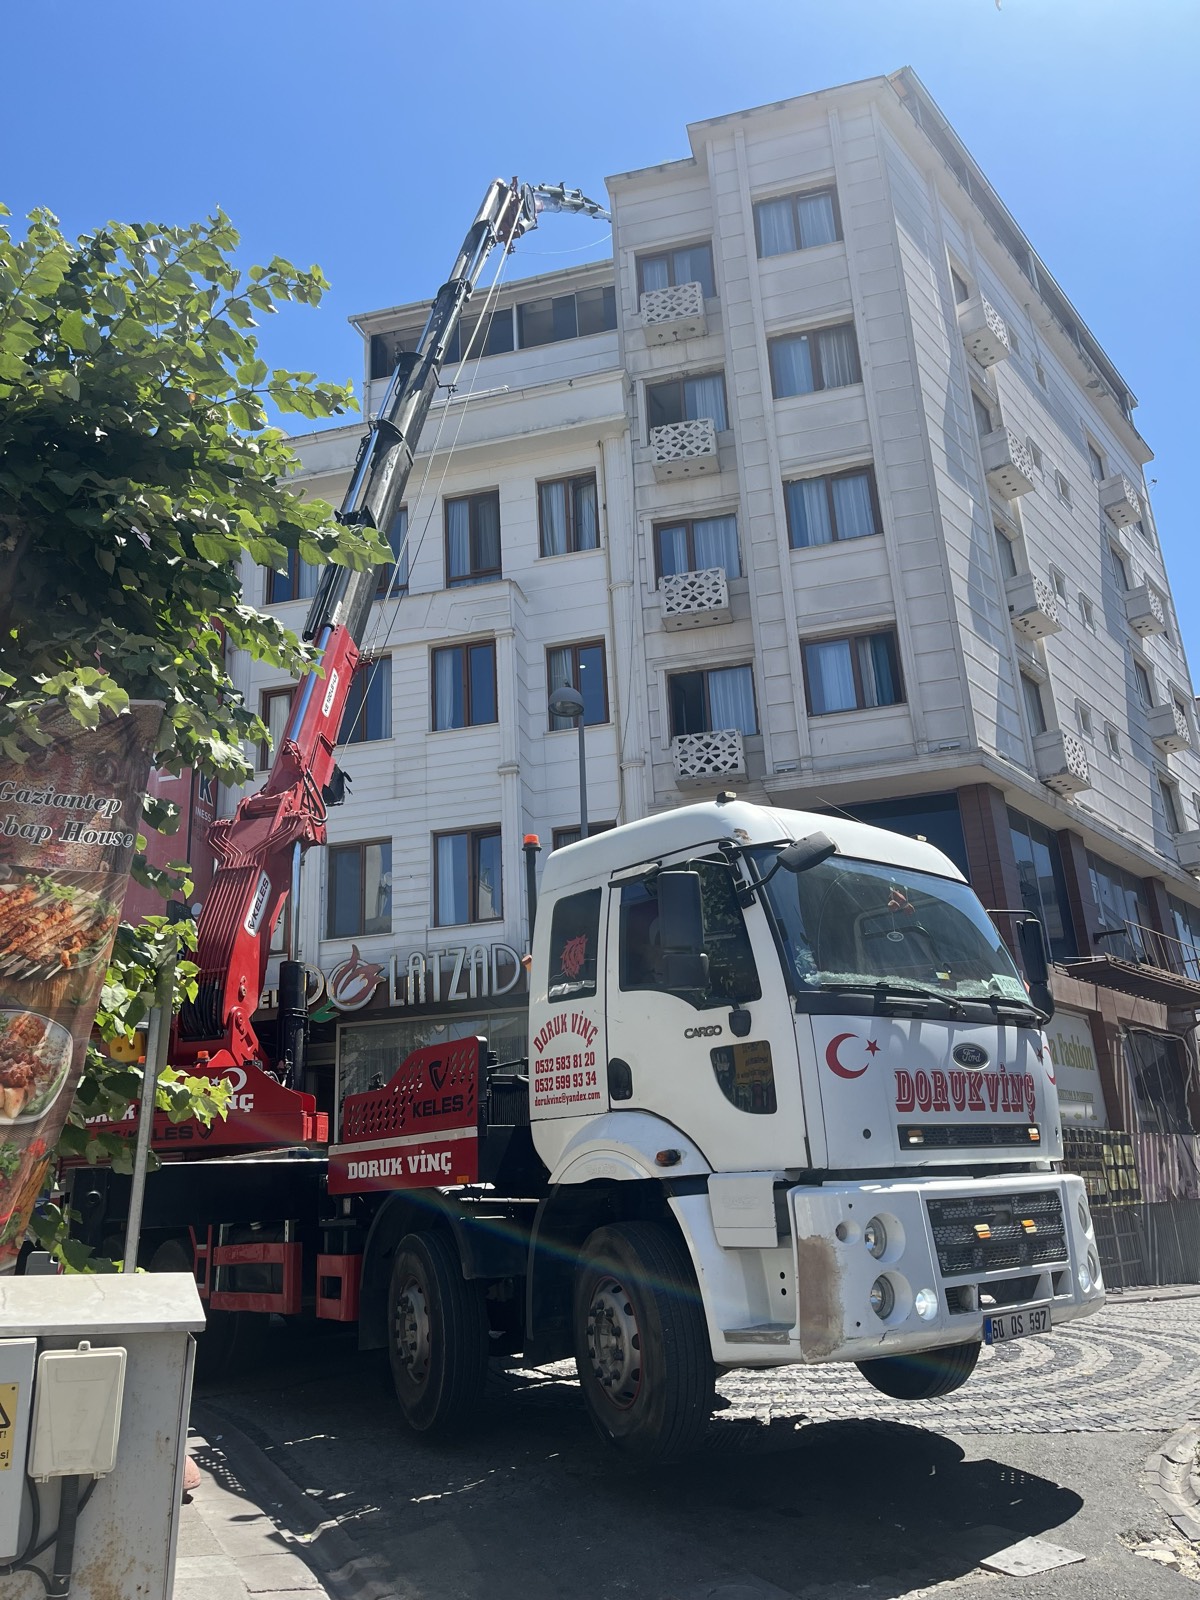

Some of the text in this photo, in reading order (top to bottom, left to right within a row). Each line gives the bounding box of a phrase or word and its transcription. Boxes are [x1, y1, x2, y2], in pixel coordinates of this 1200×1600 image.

[0, 781, 122, 818] Gaziantep
[0, 815, 134, 848] bap House
[252, 877, 269, 922] KELES
[533, 1010, 599, 1054] DORUK VİNÇ
[684, 1025, 722, 1038] CARGO
[535, 1051, 596, 1074] 0532 583 81 20
[962, 1048, 981, 1063] Ford
[1056, 1032, 1095, 1071] Fashion
[535, 1070, 597, 1093] 0532 599 93 34
[413, 1095, 464, 1118] KELES
[534, 1091, 601, 1107] dorukvinc@yandex.com
[347, 1149, 452, 1180] DORUK VİNÇ
[992, 1319, 1005, 1339] 60
[1029, 1311, 1047, 1331] 597
